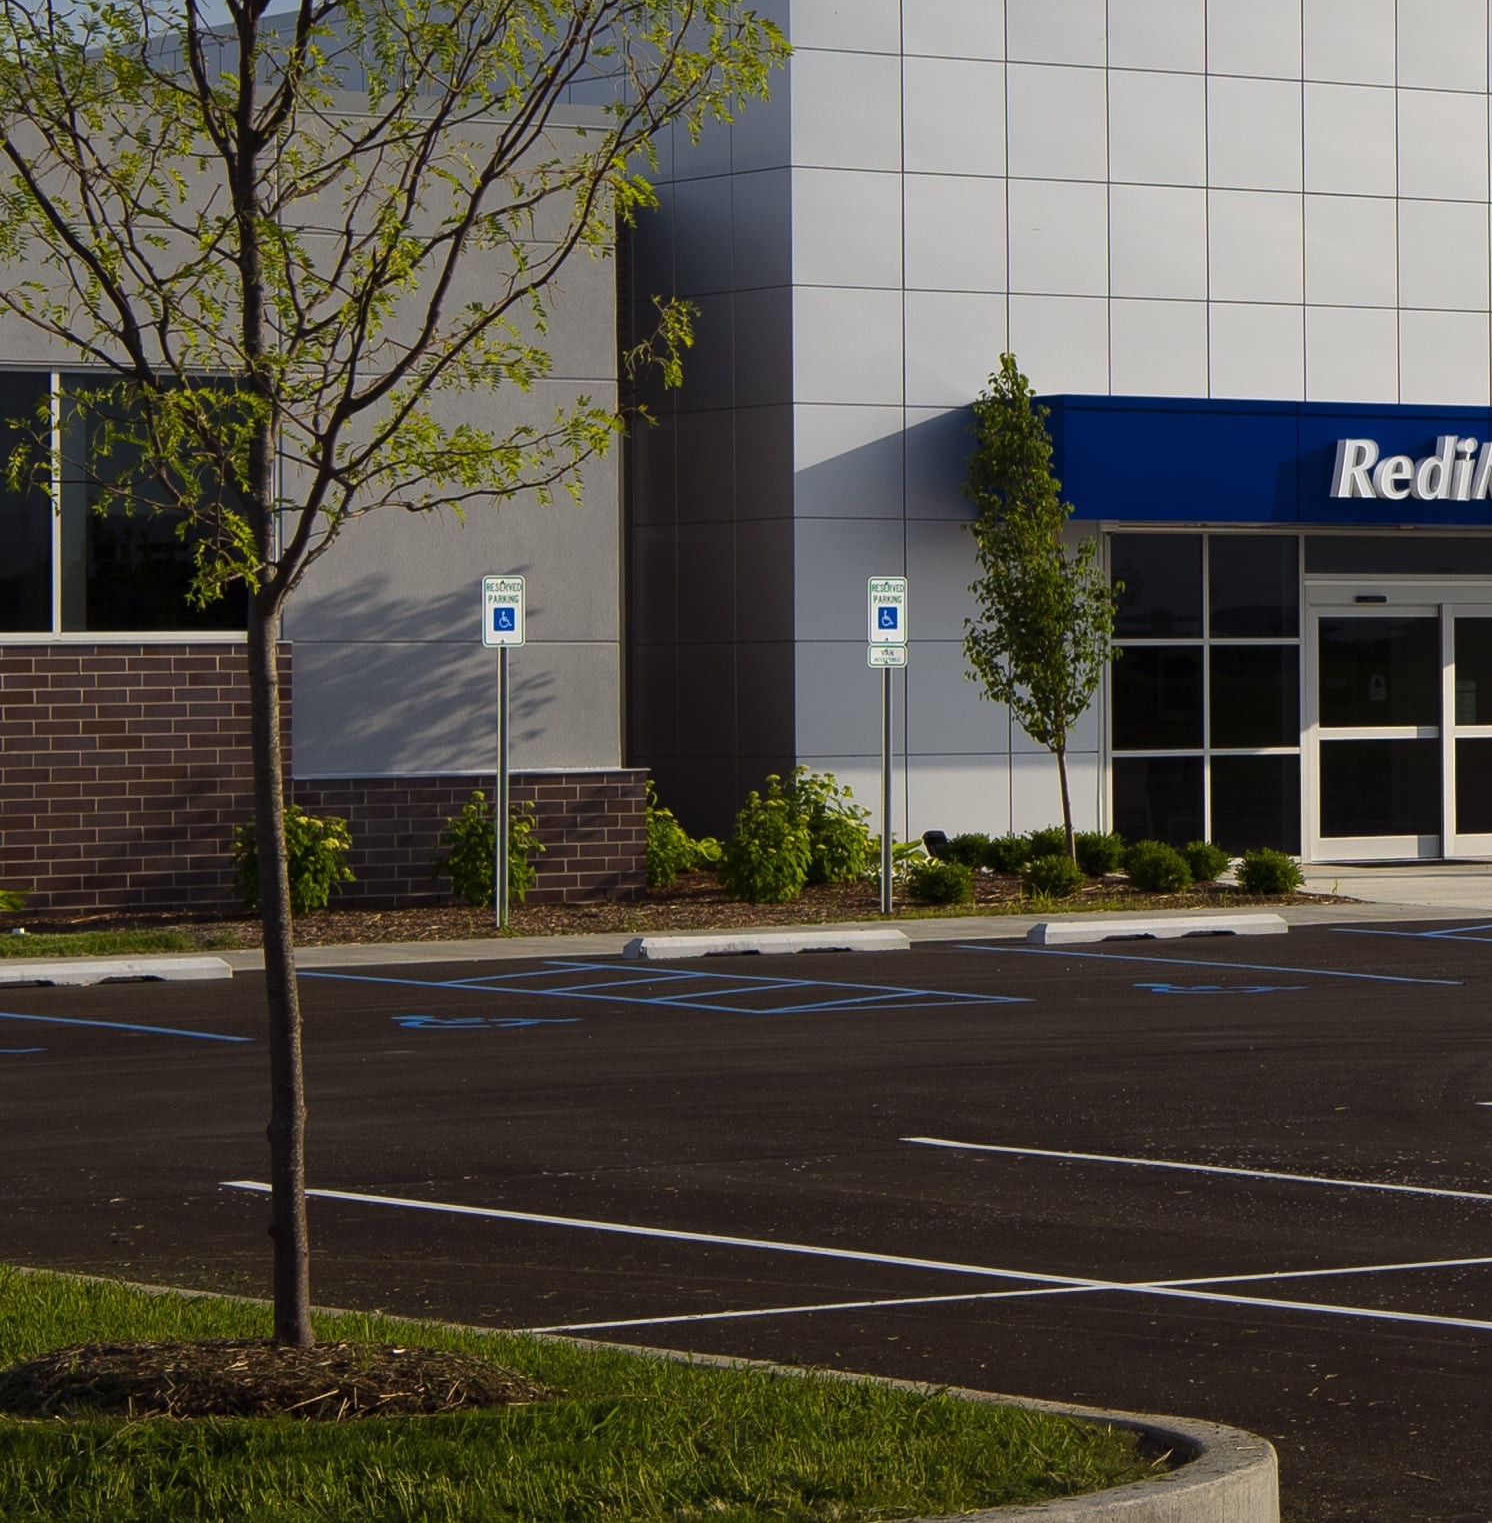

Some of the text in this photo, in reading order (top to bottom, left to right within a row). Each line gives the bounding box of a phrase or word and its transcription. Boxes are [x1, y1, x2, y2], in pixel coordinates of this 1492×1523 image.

[486, 582, 522, 591] RESERVED
[871, 583, 904, 592] RESERVED
[488, 595, 519, 603] PARKING
[873, 595, 902, 603] PARKING
